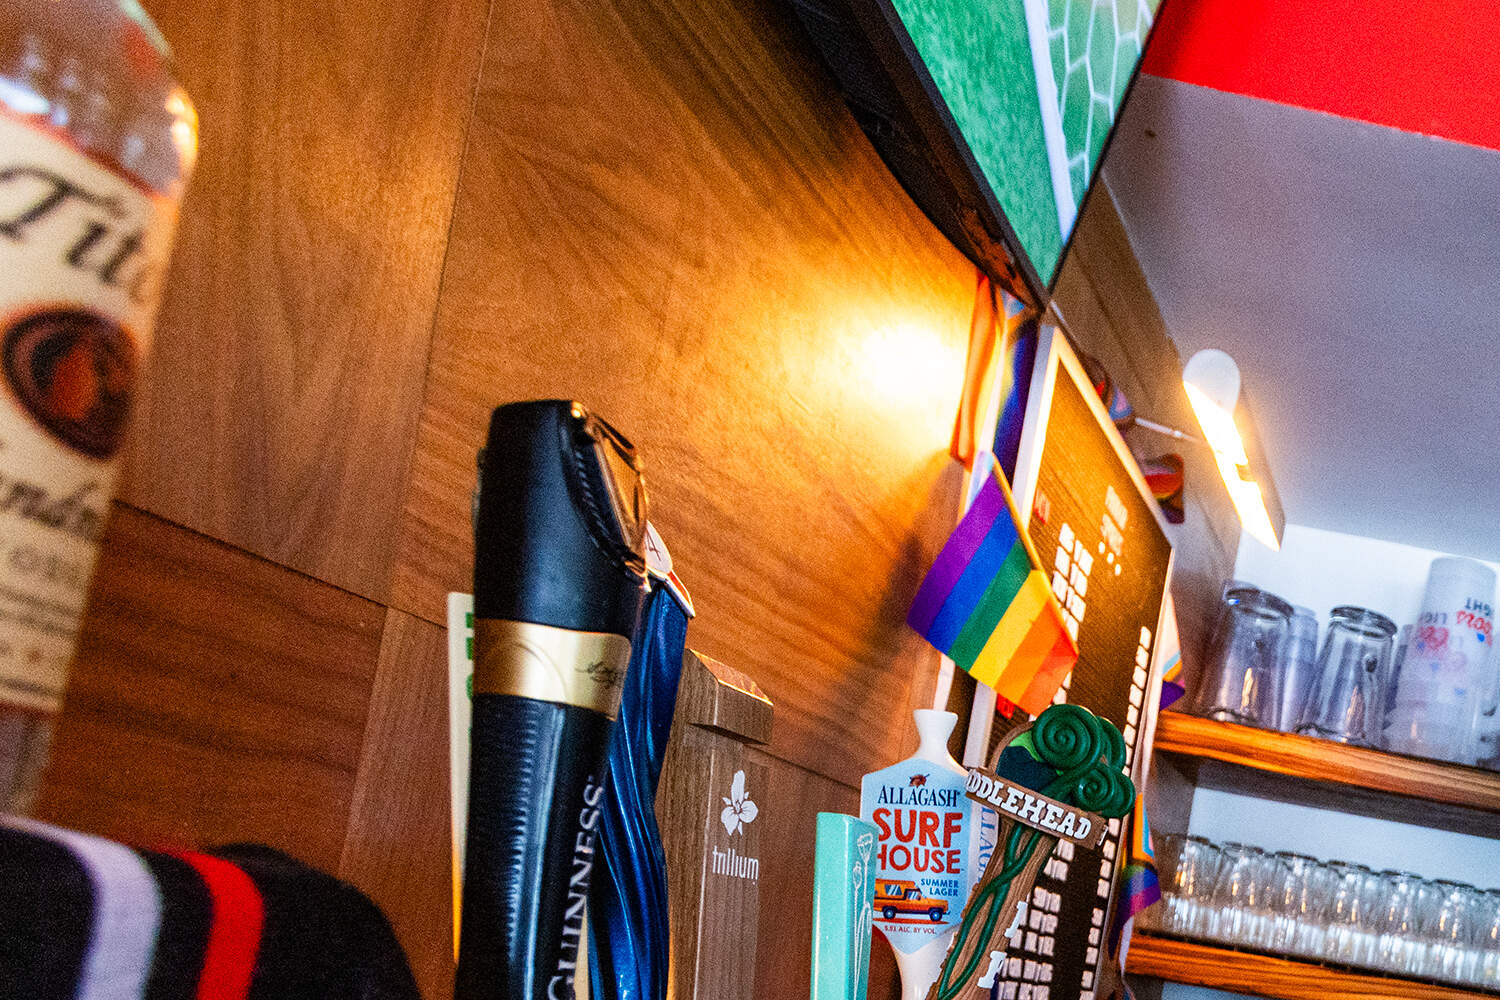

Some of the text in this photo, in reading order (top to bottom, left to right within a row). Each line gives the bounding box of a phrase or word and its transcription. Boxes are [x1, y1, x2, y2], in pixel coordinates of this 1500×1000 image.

[877, 784, 958, 808] ALLAGASH
[872, 808, 963, 848] SURF
[712, 845, 759, 880] trillium
[877, 845, 961, 875] HOUSE
[920, 878, 959, 889] SUMMER
[929, 887, 958, 897] LAGER
